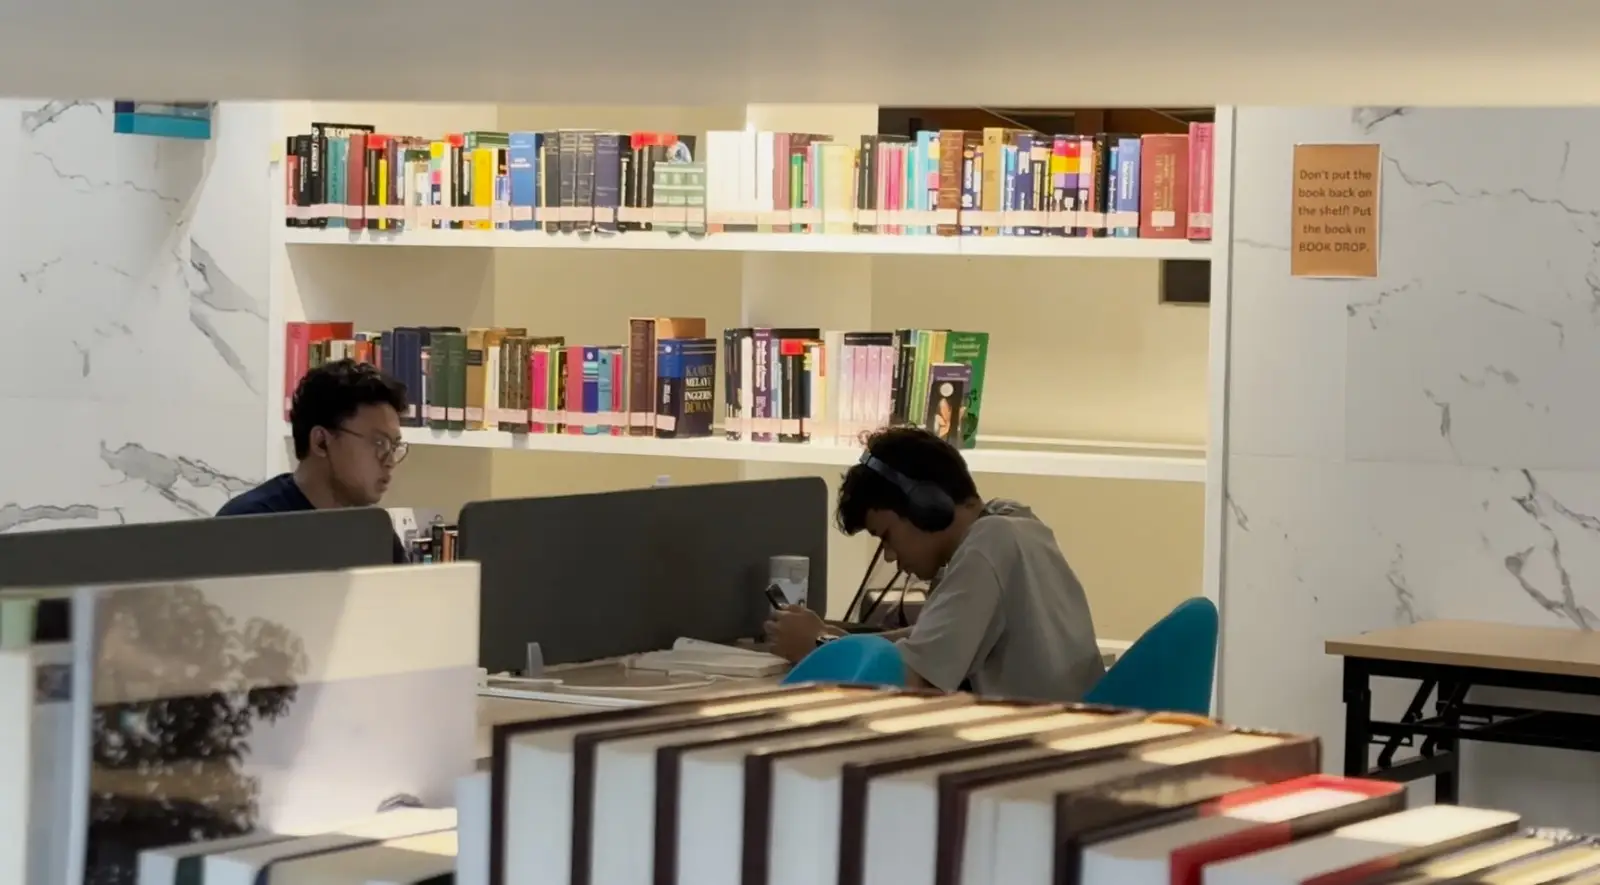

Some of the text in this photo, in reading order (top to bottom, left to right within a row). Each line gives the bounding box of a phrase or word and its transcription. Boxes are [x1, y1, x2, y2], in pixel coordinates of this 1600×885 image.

[1299, 169, 1372, 183] Don't put the
[1298, 188, 1372, 198] book back on
[1298, 205, 1372, 216] the shelf! Put
[1303, 223, 1366, 234] the book in
[1299, 242, 1370, 252] BOOK DROP.
[685, 402, 713, 414] DEWAN
